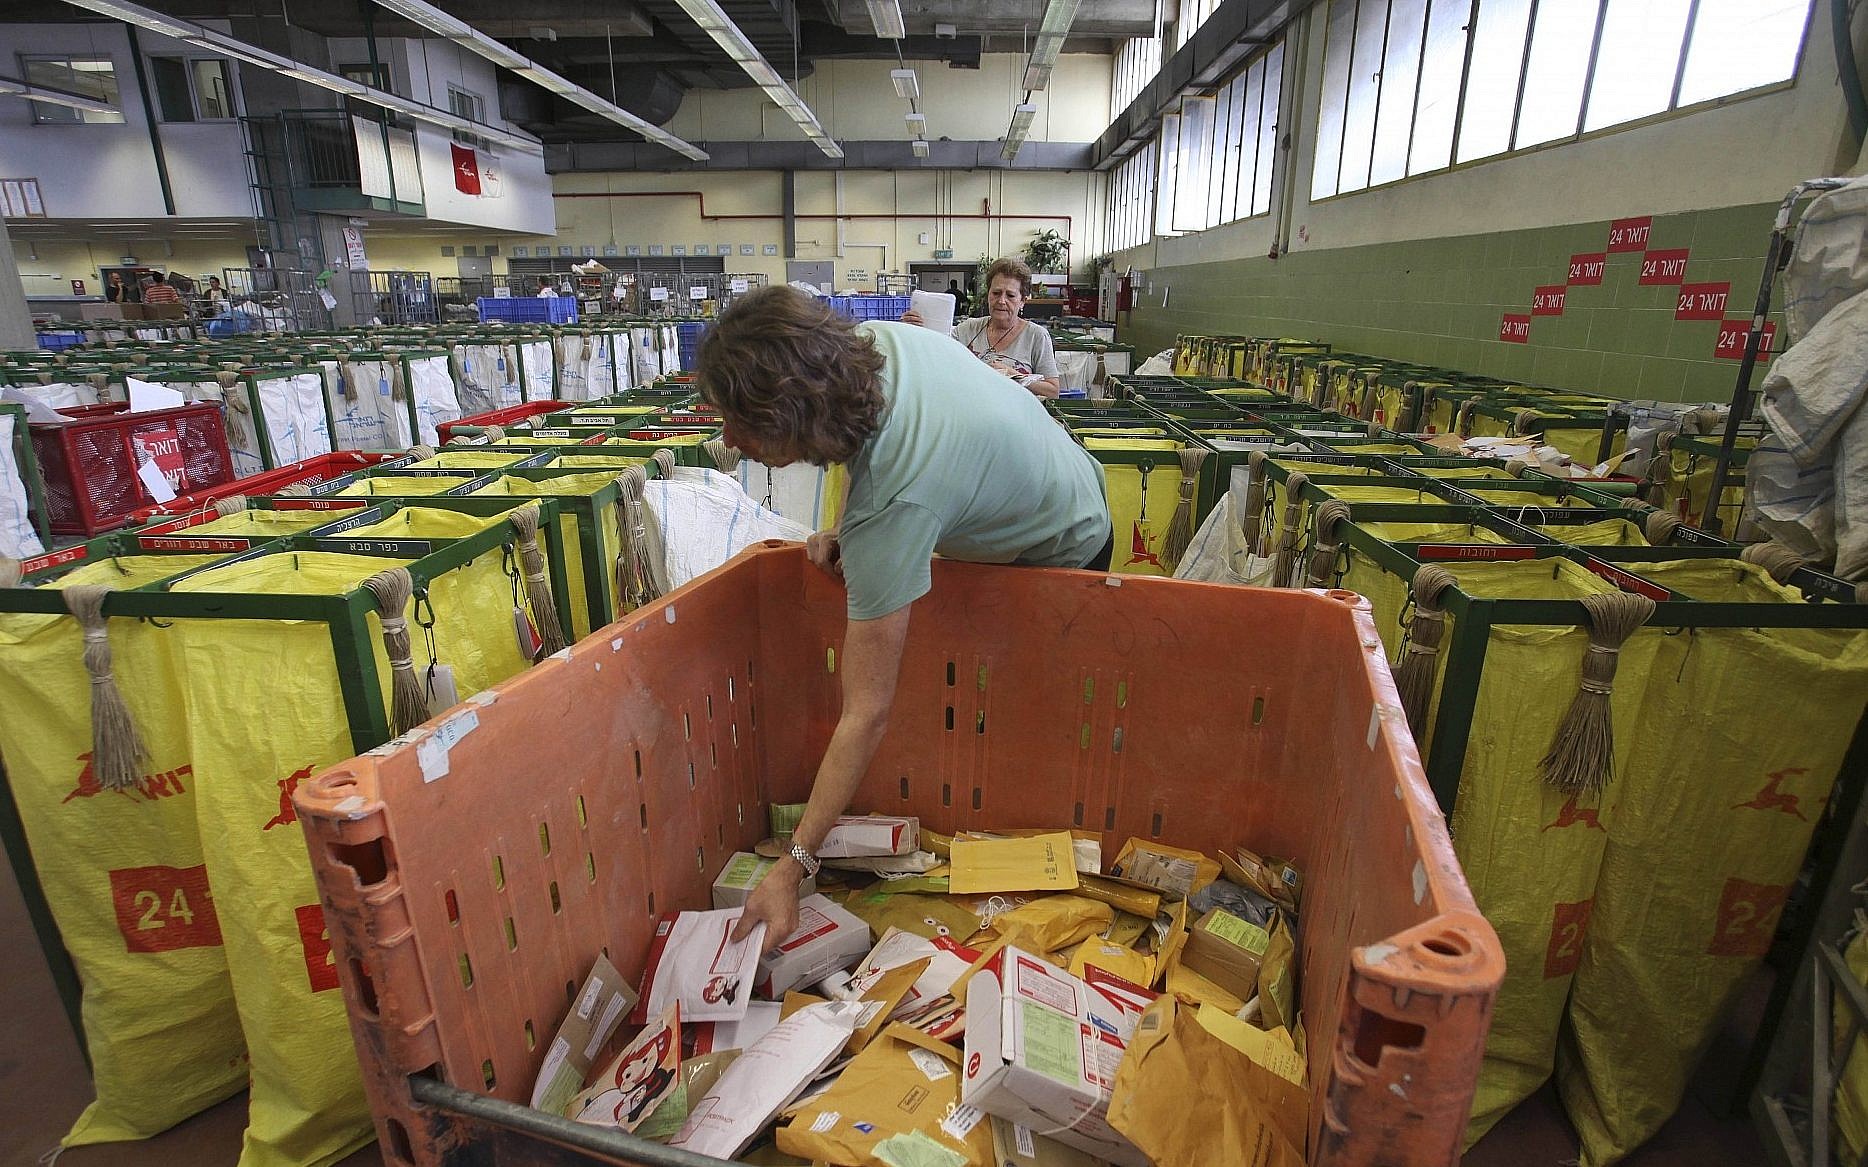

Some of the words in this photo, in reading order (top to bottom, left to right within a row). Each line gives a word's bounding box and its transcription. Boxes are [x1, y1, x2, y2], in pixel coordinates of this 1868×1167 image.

[1609, 229, 1623, 245] 24
[1626, 226, 1650, 244] דואר
[1568, 263, 1581, 278] 24
[1584, 262, 1605, 277] דואר
[1641, 260, 1657, 277] 24
[1661, 259, 1686, 276] דואר
[1533, 295, 1544, 309] 24
[1547, 294, 1565, 308] דואר
[1677, 294, 1695, 311] 24
[1699, 293, 1727, 311] דואר
[1501, 321, 1511, 335] 24
[1513, 323, 1530, 336] דואר
[1717, 330, 1736, 349] 24
[1741, 331, 1773, 351] דור
[149, 438, 179, 456] דואר
[164, 467, 186, 481] דוא
[336, 518, 361, 533] הרצליה
[189, 539, 210, 549] שבע
[219, 540, 237, 550] באר
[350, 541, 371, 552] סבא
[376, 541, 399, 552] כפר
[55, 550, 76, 562] באר
[1460, 547, 1497, 557] רחובות
[133, 888, 195, 931] 24
